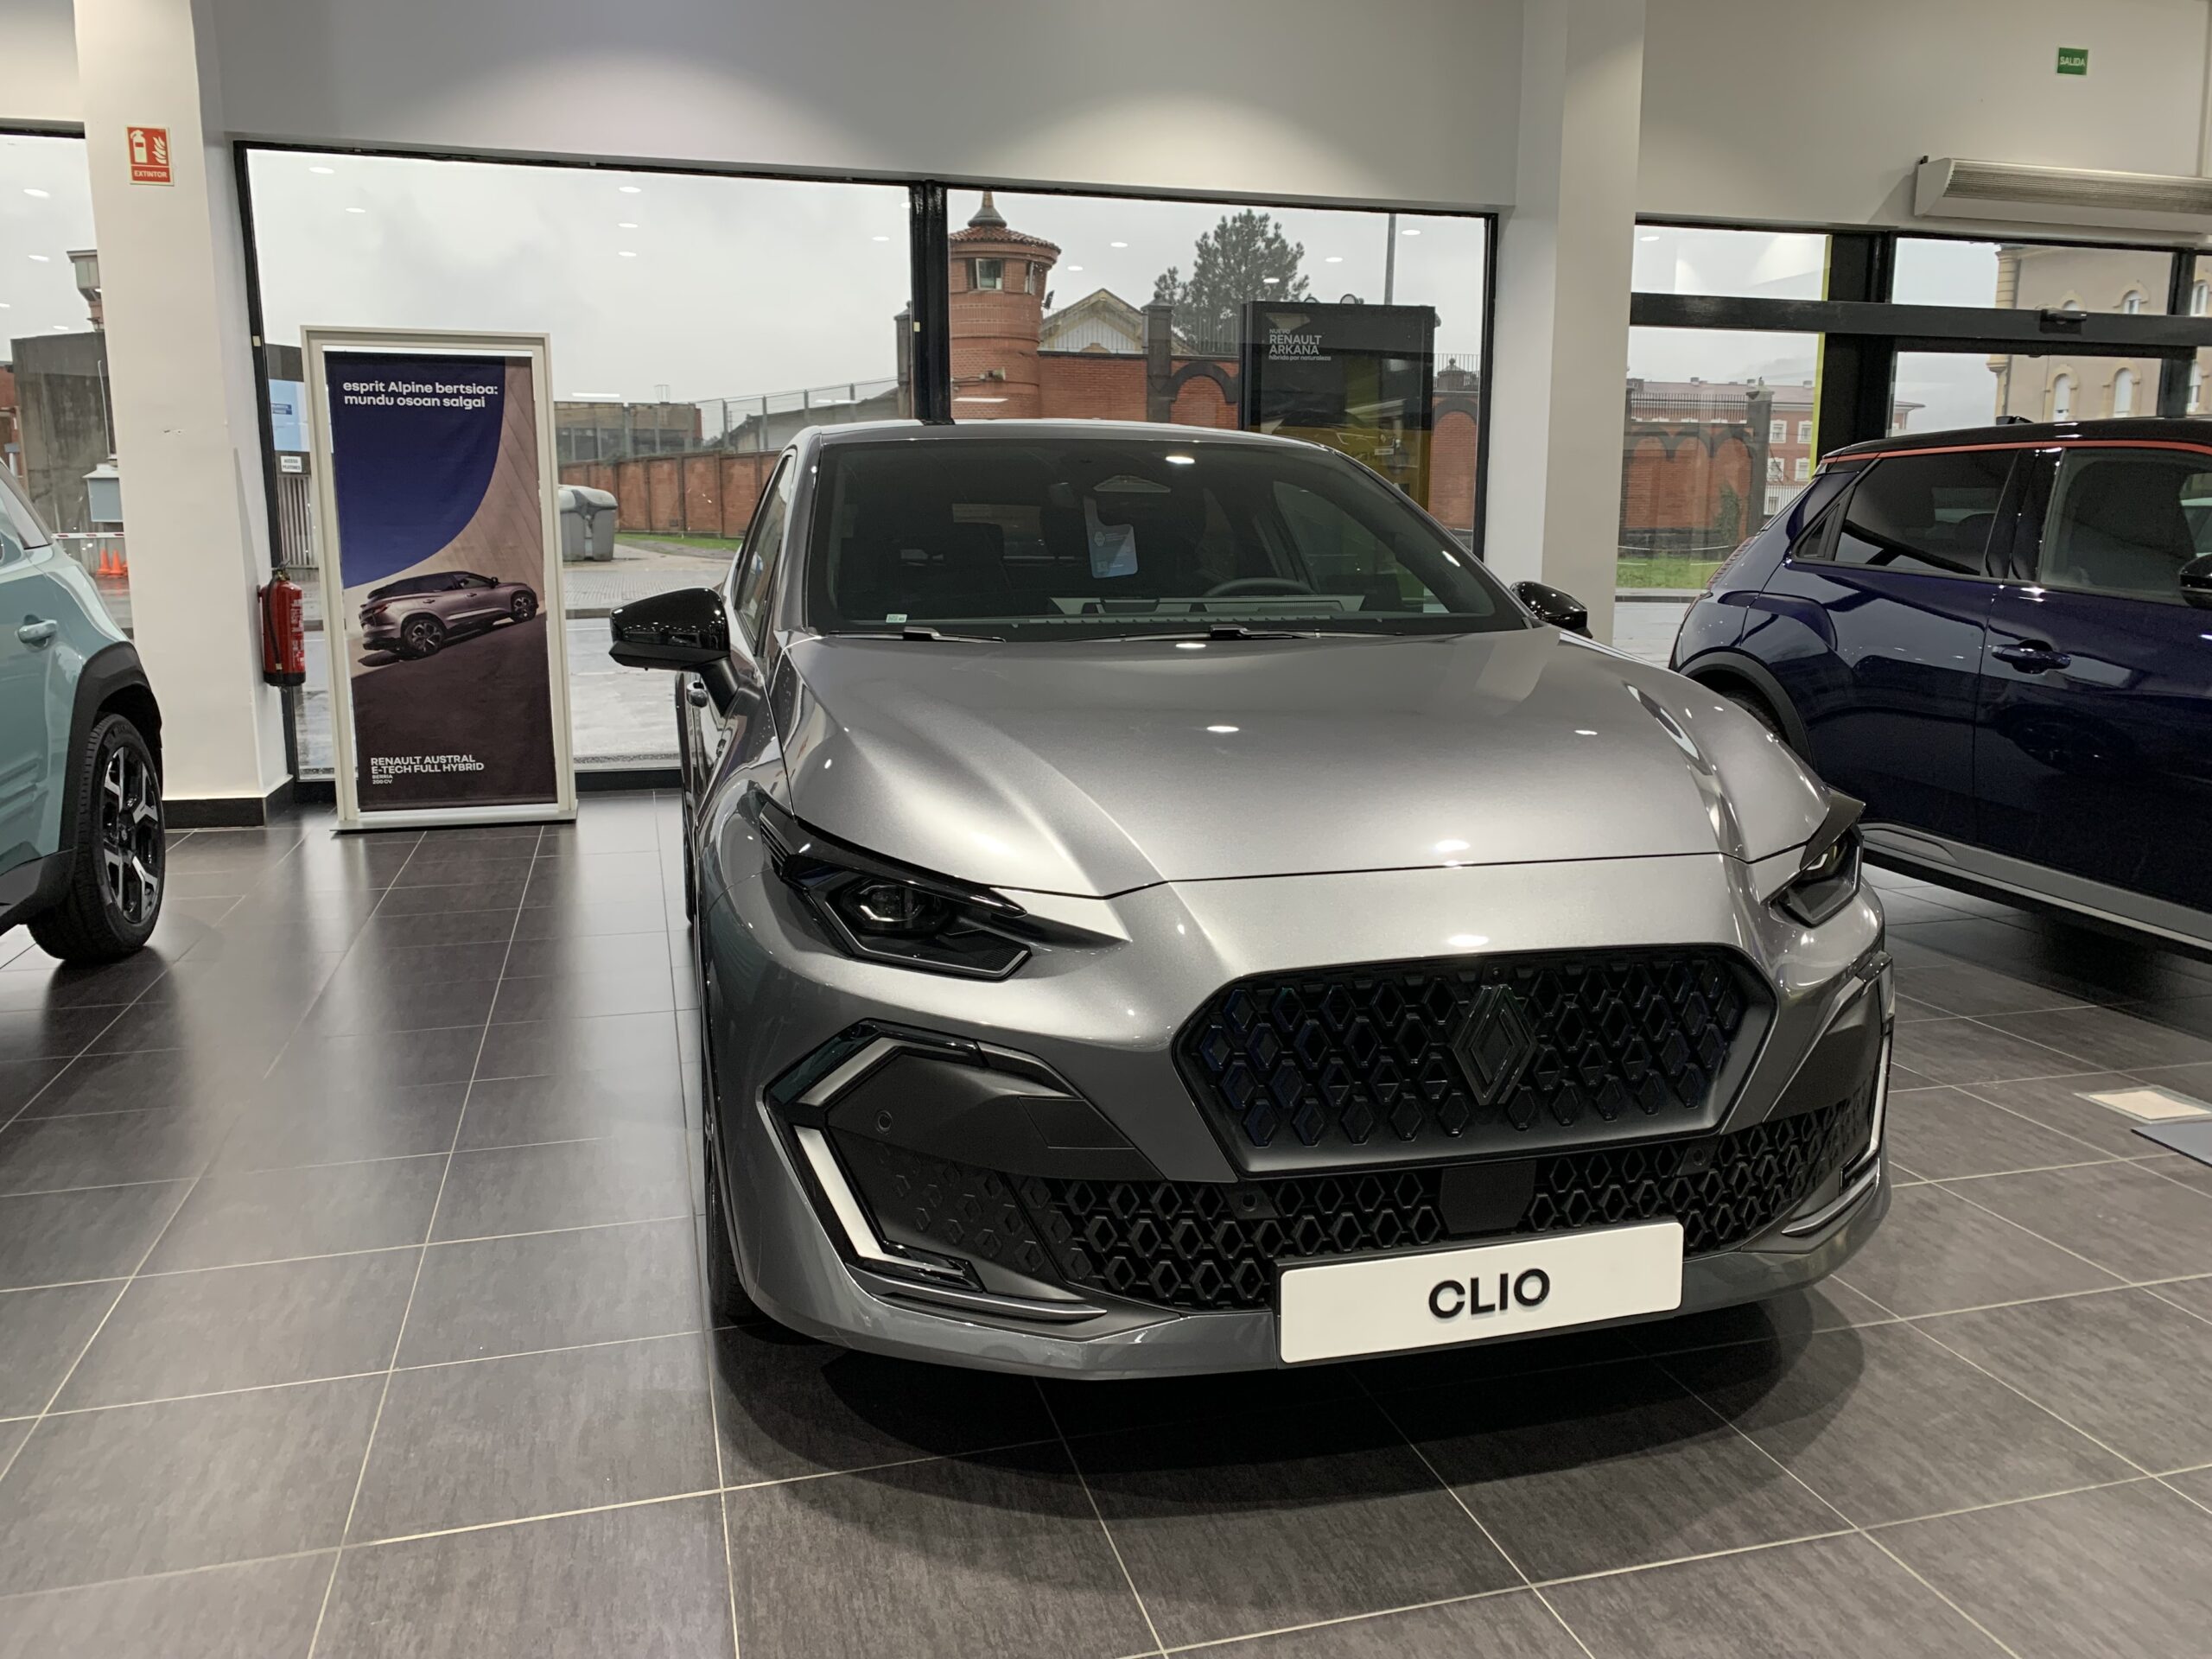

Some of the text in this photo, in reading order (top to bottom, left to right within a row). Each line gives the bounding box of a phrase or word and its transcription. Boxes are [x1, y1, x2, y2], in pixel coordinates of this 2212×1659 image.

[2060, 56, 2086, 67] SALIDA
[1269, 334, 1322, 345] RENAULT
[1268, 345, 1319, 355] ARKANA
[342, 380, 499, 396] esprit Alpine bertsioa:
[344, 394, 486, 410] mundu osoan salgai
[371, 754, 476, 766] RENAULT AUSTRAL
[372, 762, 485, 774] E-TECH FULL HYBRID
[1428, 1268, 1551, 1319] CLIO
